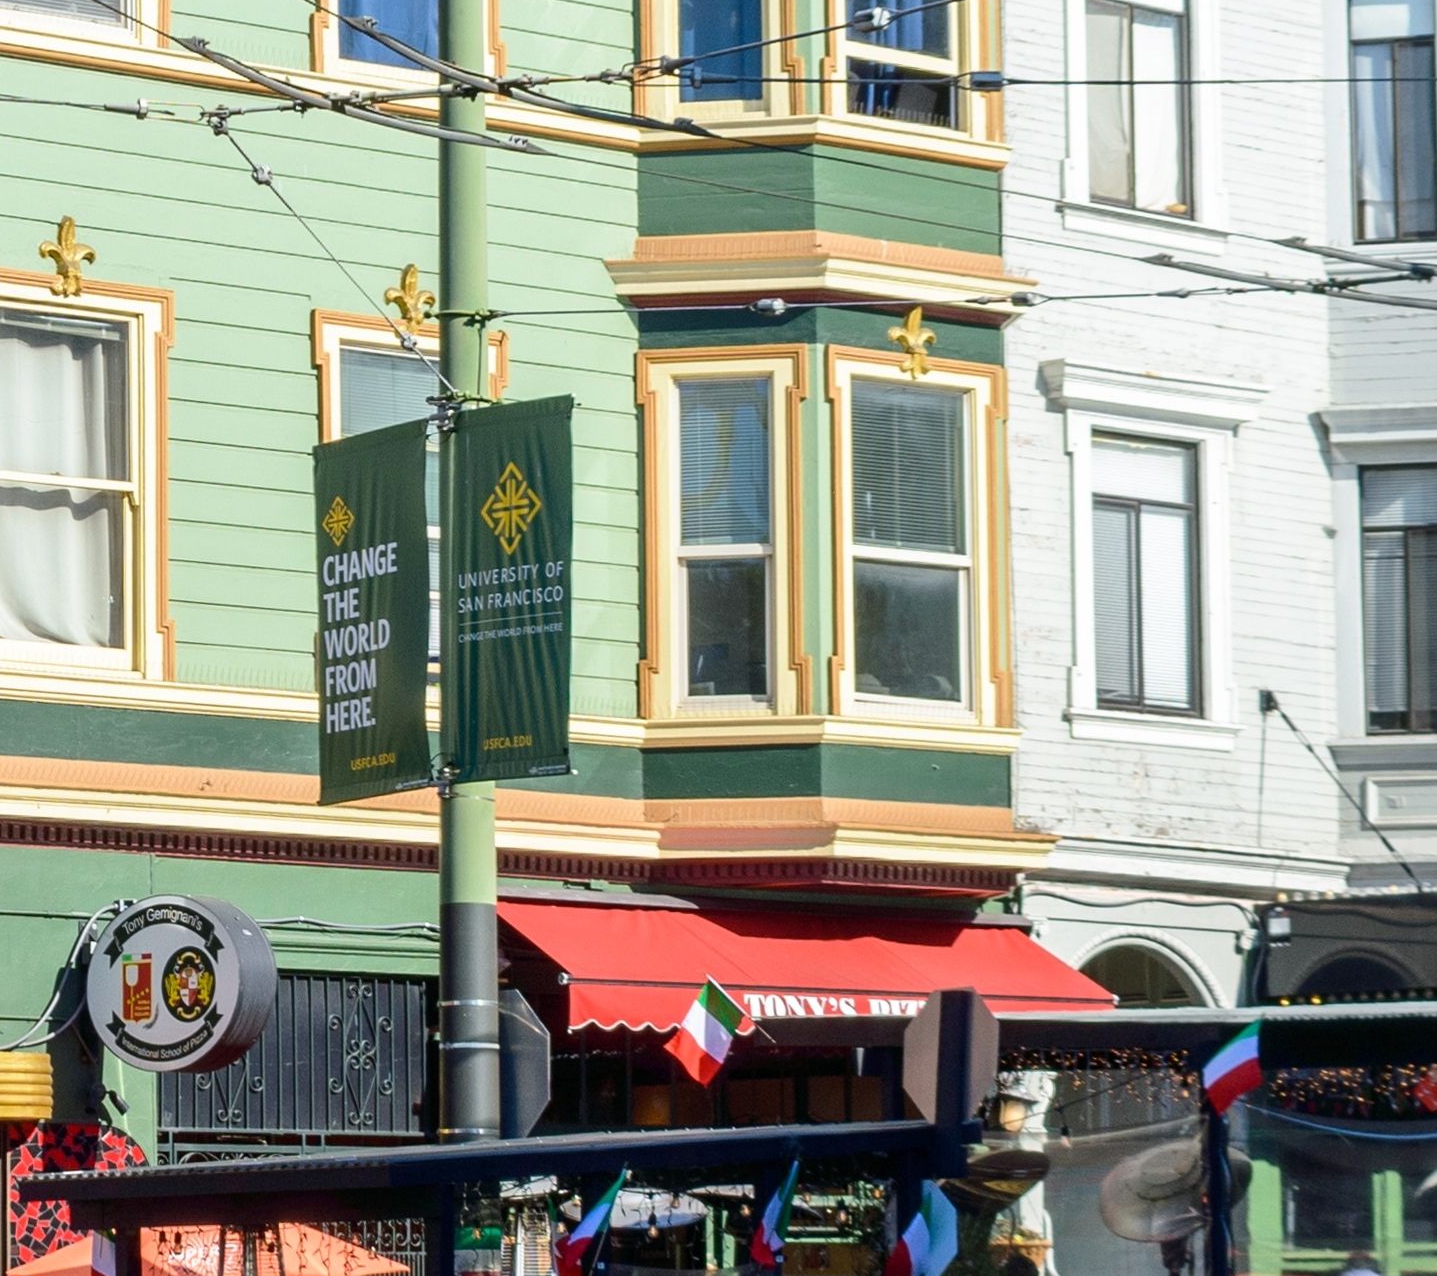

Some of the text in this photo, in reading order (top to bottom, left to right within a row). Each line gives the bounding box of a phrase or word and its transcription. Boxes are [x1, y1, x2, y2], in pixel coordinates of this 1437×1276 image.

[323, 542, 397, 587] CHANGE
[458, 561, 564, 590] UNIVERSITY OF
[324, 588, 359, 623] THE
[458, 585, 564, 613] SAN FRANCISCO
[324, 619, 390, 659] WORLD
[458, 631, 483, 643] CHANGE
[497, 627, 521, 638] WORLD
[544, 622, 563, 632] HERE
[325, 661, 376, 696] FROM
[326, 699, 376, 734] HERE.
[351, 752, 396, 771] USFCA.EDU
[122, 906, 203, 935] Tony Gemignani's
[160, 1047, 183, 1059] School
[182, 1041, 190, 1053] of
